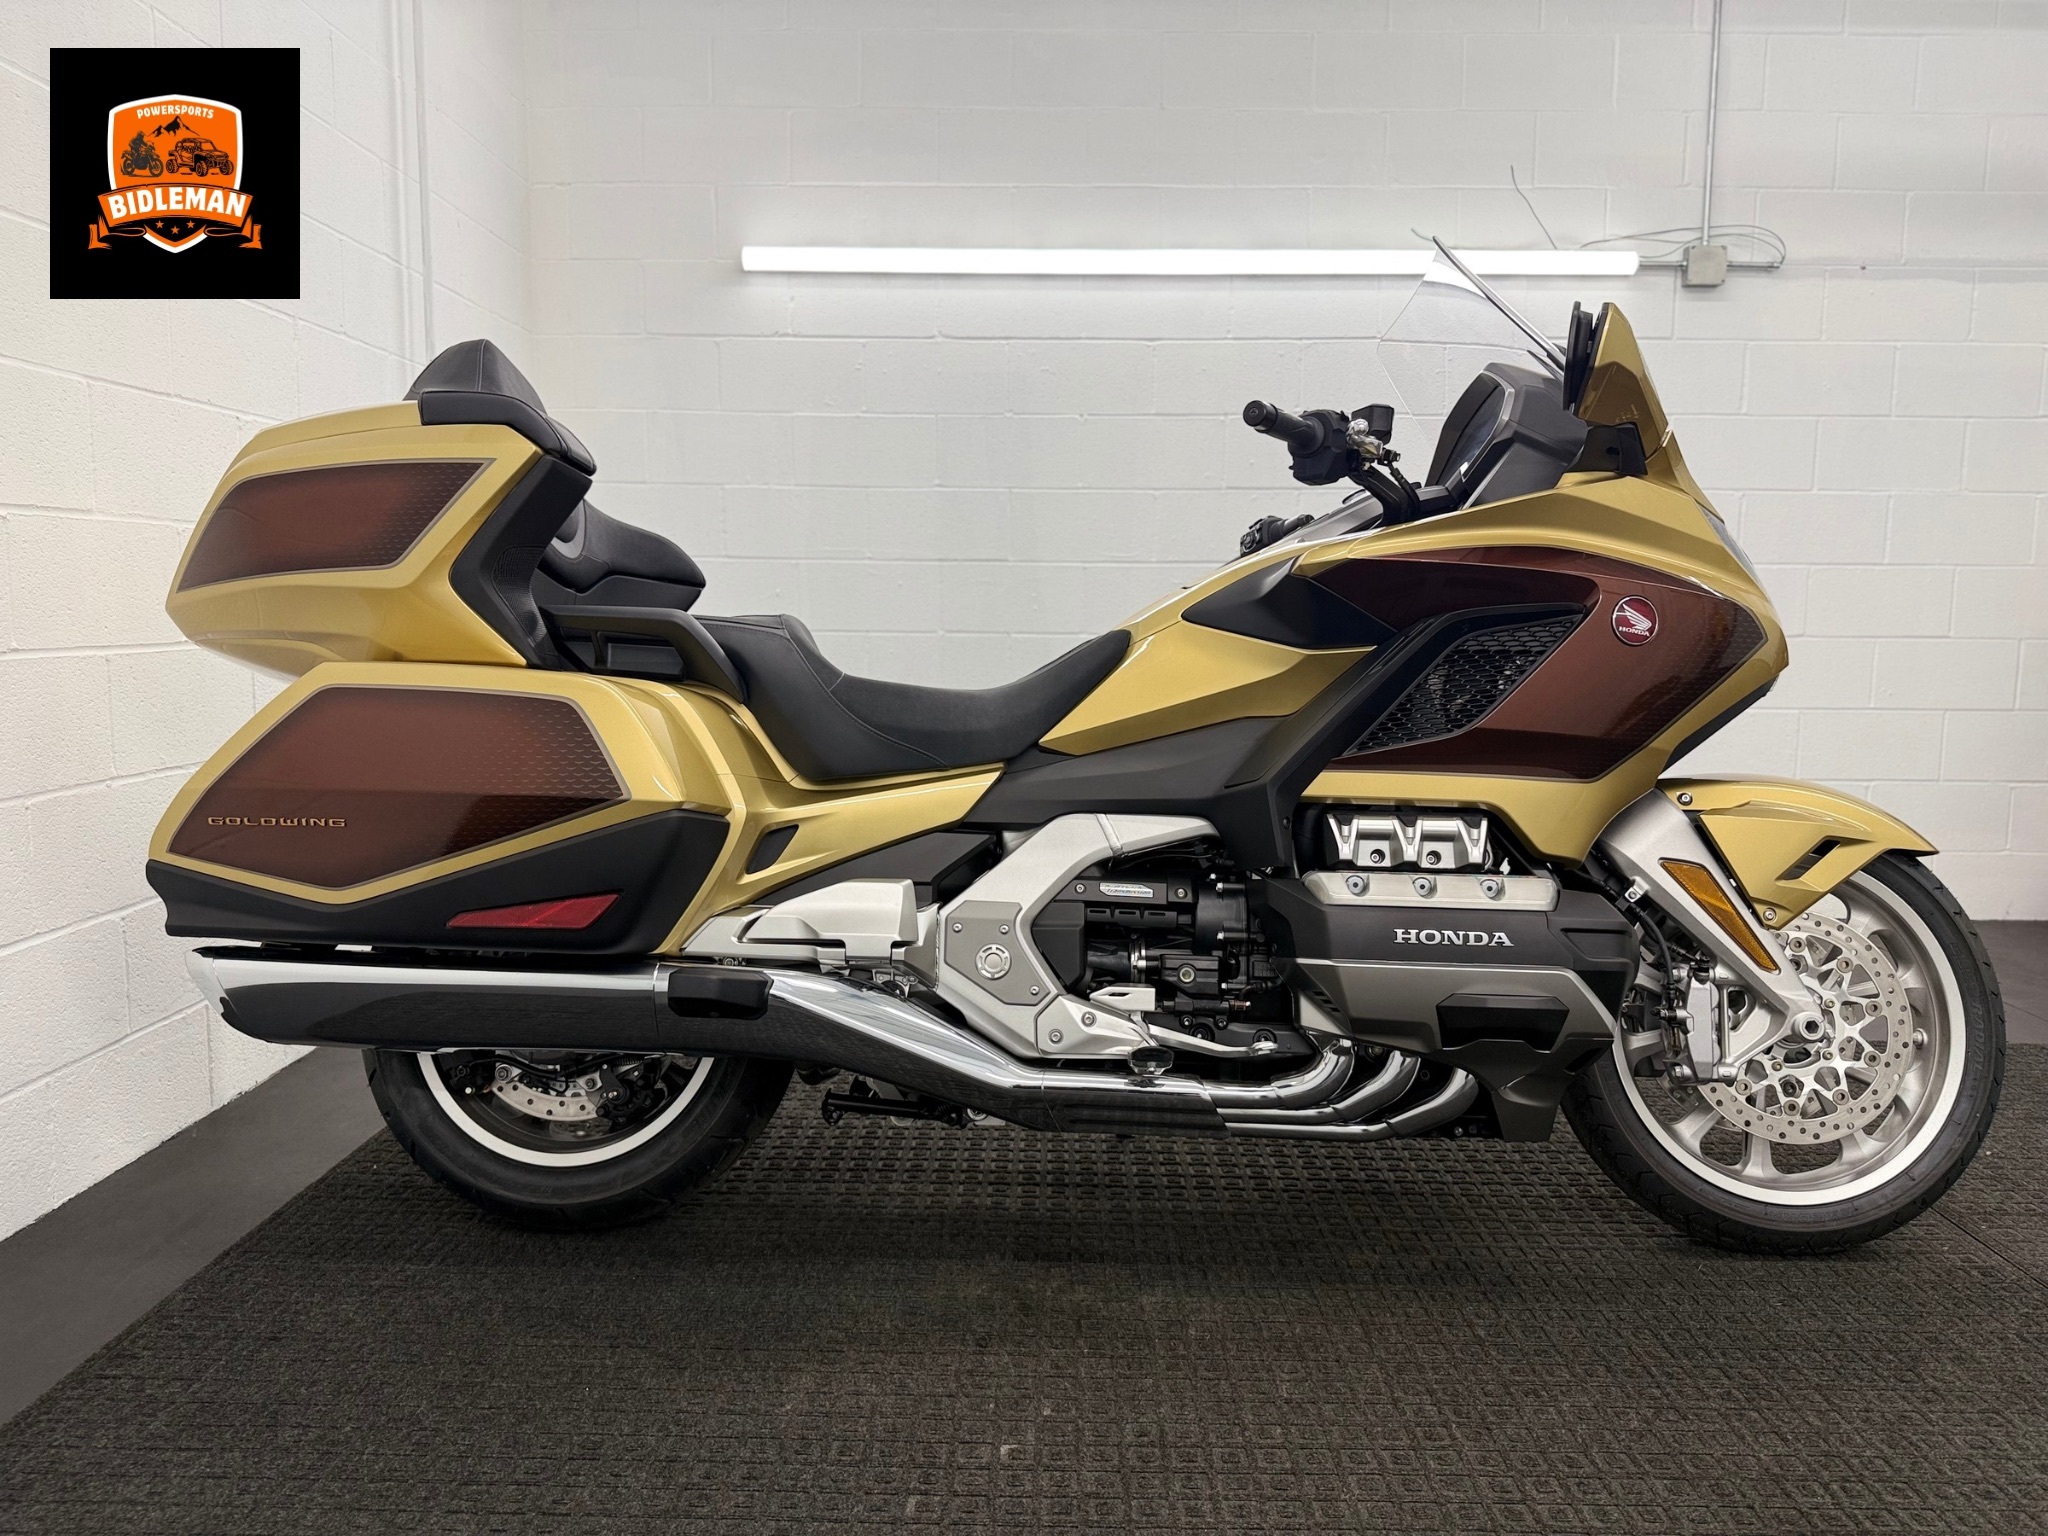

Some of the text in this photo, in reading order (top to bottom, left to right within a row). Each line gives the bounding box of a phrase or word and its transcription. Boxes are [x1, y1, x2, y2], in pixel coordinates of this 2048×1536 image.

[1618, 626, 1650, 637] HONDA
[207, 816, 347, 827] GOLDWING
[1393, 928, 1515, 947] HONDA
